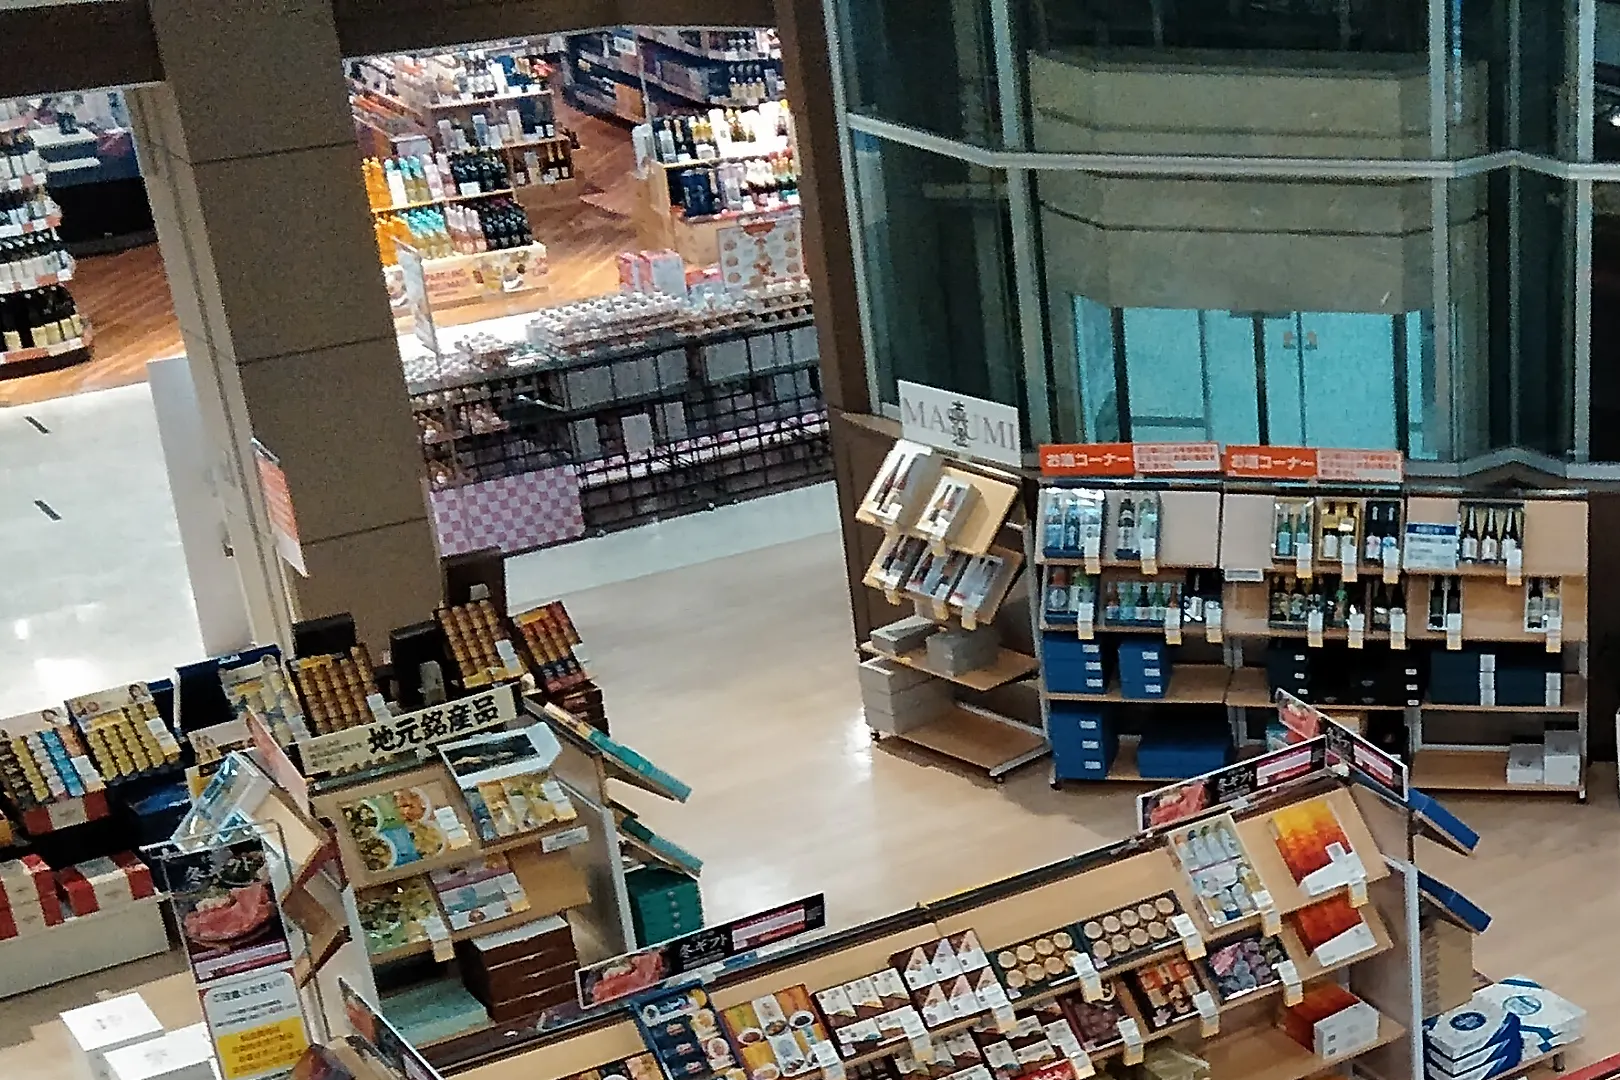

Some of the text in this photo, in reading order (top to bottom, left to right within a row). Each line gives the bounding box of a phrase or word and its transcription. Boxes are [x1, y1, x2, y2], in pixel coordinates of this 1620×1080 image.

[367, 694, 499, 753] 地元銘産品
